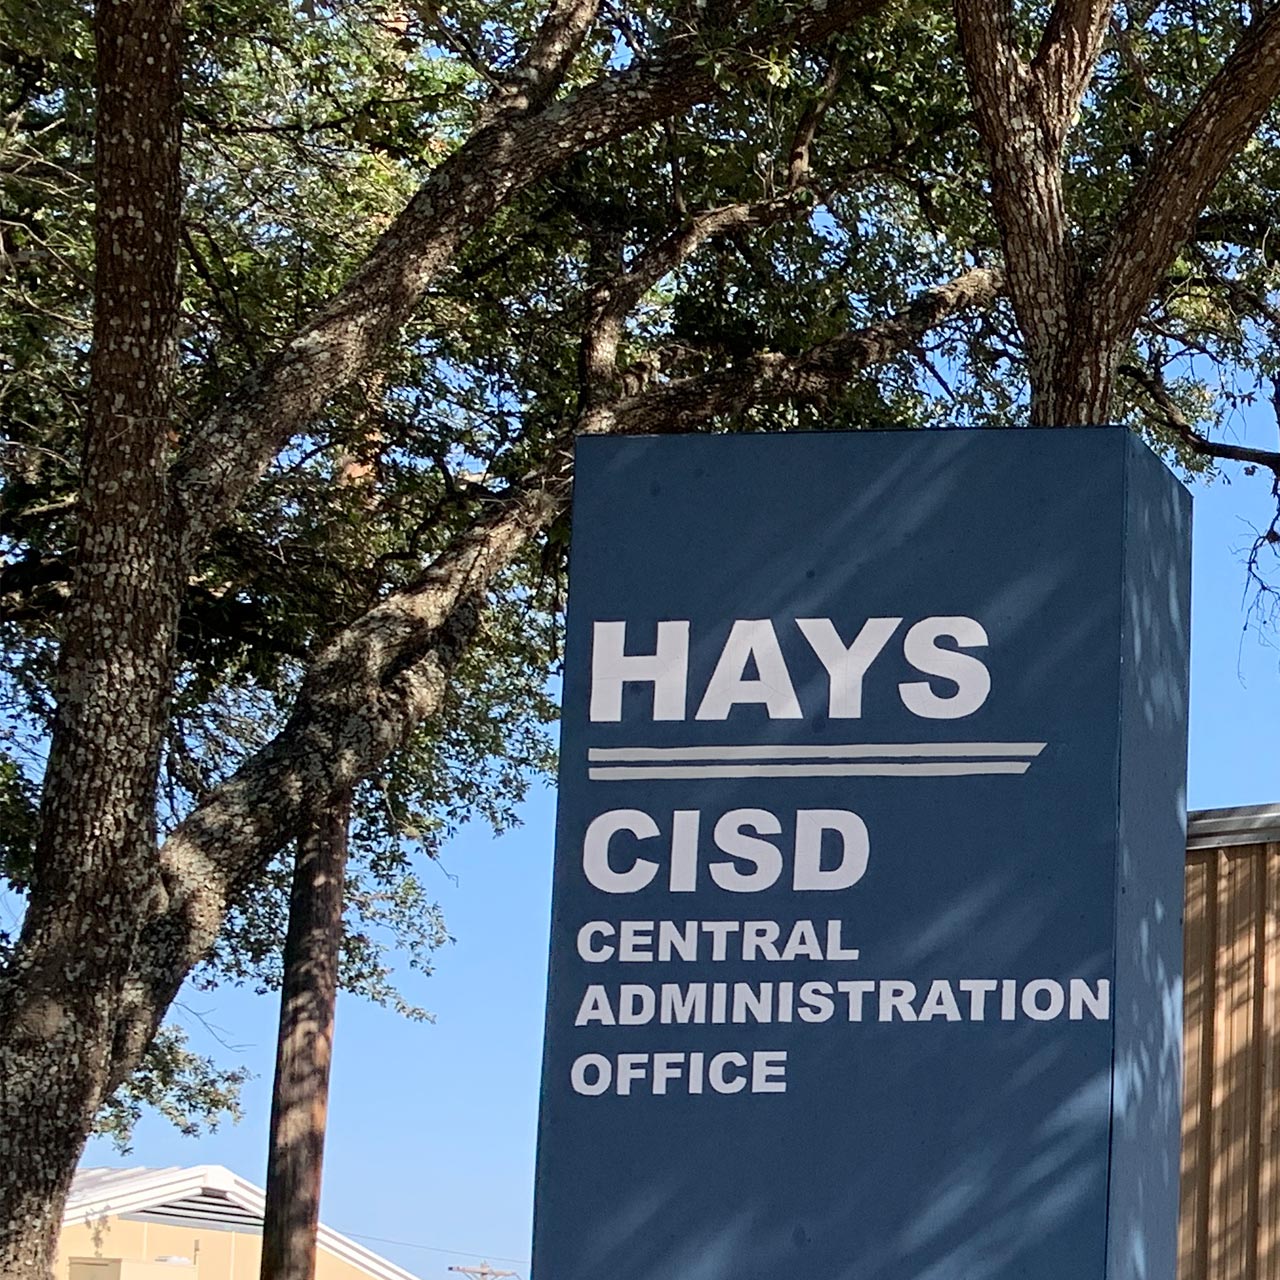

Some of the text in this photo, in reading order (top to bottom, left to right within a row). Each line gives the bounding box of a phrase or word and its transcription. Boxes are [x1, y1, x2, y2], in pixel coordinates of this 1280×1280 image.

[589, 616, 991, 722] HAYS
[582, 808, 870, 894] CISD
[577, 919, 860, 963] CENTRAL
[574, 978, 1110, 1027] ADMINISTRATION
[571, 1051, 788, 1096] OFFICE
